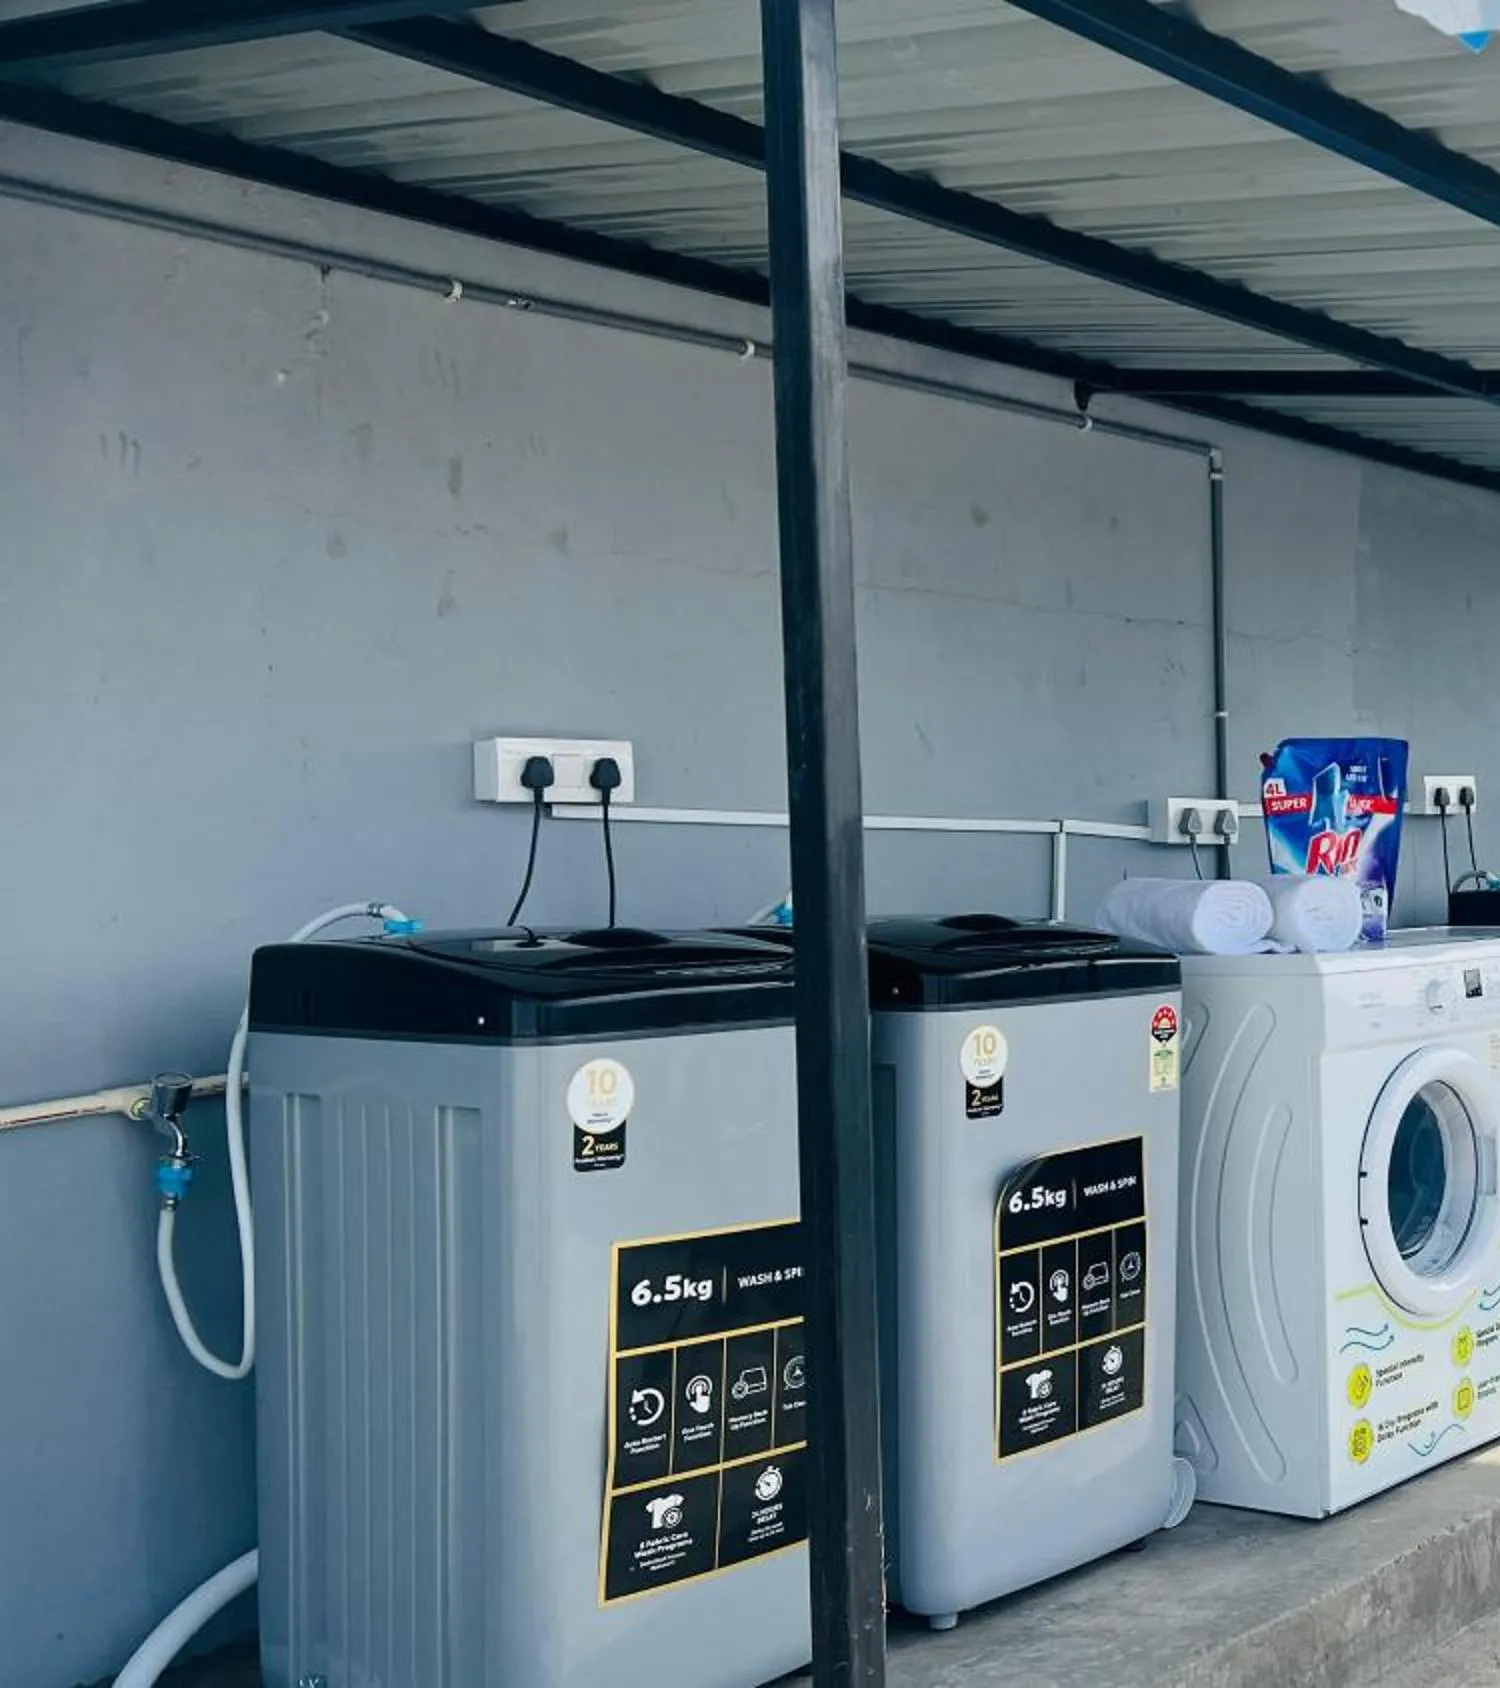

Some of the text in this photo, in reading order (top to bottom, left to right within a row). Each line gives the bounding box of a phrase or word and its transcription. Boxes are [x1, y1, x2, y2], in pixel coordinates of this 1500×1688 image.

[1271, 797, 1307, 811] SUPER
[1306, 827, 1363, 876] Rin
[973, 1031, 997, 1056] 10
[586, 1068, 617, 1095] 10
[971, 1089, 981, 1107] 2
[581, 1135, 619, 1156] 2 YEARS
[1083, 1175, 1137, 1197] WASH & SPIN
[1008, 1186, 1067, 1214] 6.5kg
[631, 1274, 713, 1306] 6.5kg
[738, 1271, 773, 1289] WASH
[774, 1269, 782, 1282] &
